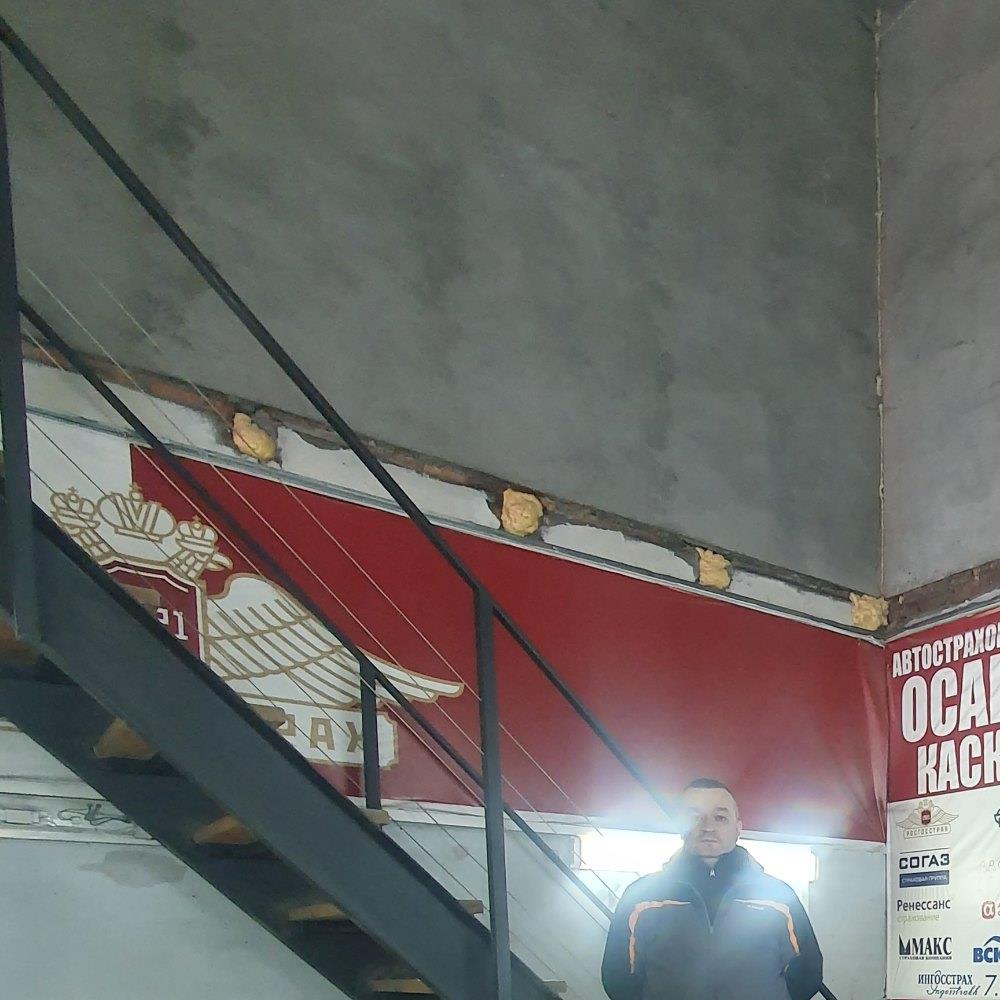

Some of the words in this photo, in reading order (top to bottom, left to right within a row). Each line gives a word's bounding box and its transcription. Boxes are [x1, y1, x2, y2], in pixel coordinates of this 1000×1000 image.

[899, 853, 950, 870] СОГАЗ
[897, 899, 951, 912] Ренессанс
[911, 936, 953, 956] МАКС
[918, 970, 973, 985] ИНГОССТРАХ
